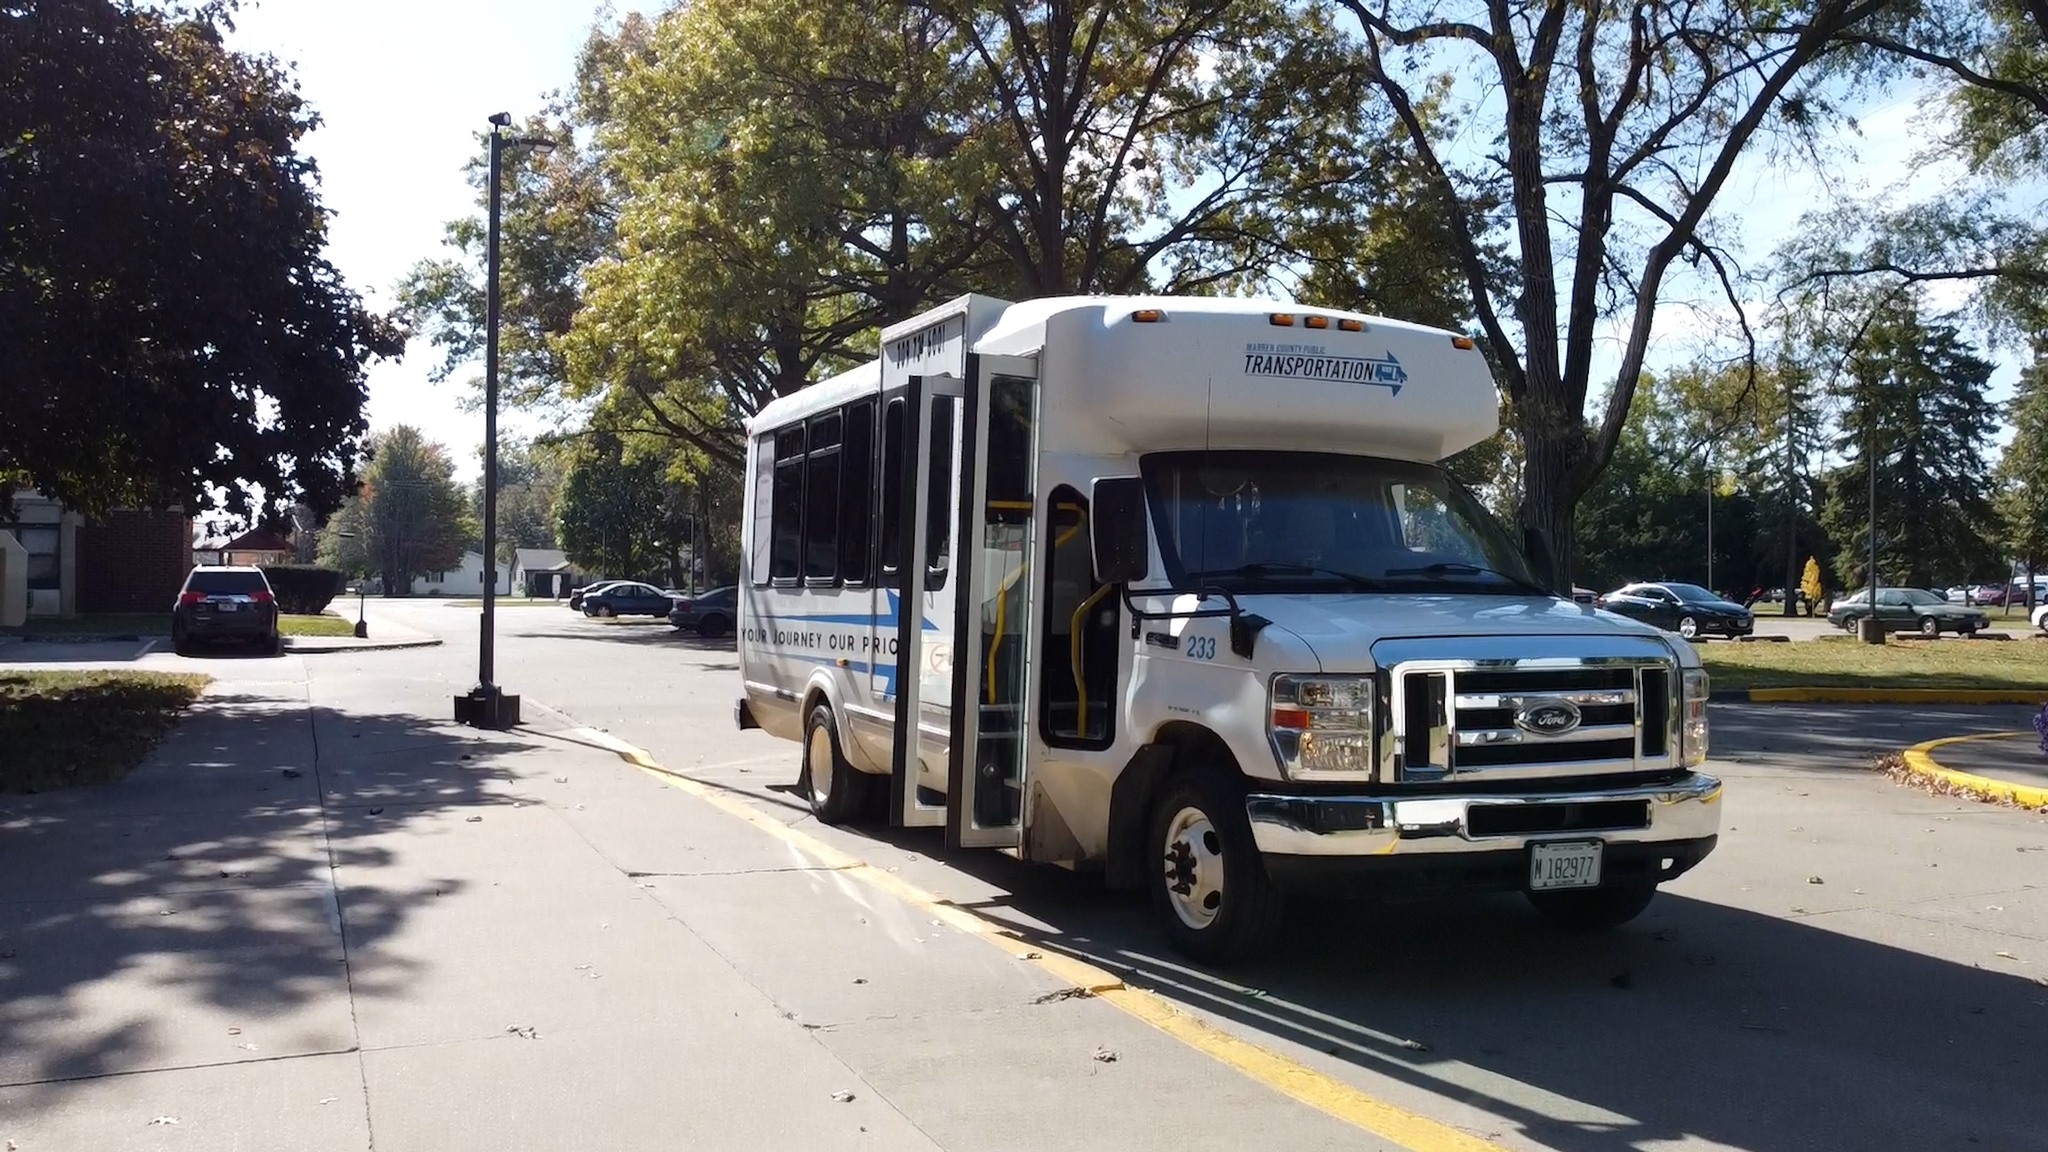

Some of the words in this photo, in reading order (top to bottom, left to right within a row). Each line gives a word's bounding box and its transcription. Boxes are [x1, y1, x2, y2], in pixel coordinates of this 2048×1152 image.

[1246, 343, 1275, 352] WARREN
[1276, 344, 1302, 353] COUNTY
[1303, 345, 1326, 354] PUBLIC
[1244, 354, 1375, 381] TRANSPORTATION
[741, 628, 767, 644] YOUR
[773, 628, 822, 649] JOURNEY
[829, 634, 855, 651] OUR
[1186, 635, 1216, 660] 233
[1538, 713, 1566, 725] Ford
[1547, 856, 1594, 880] 182977
